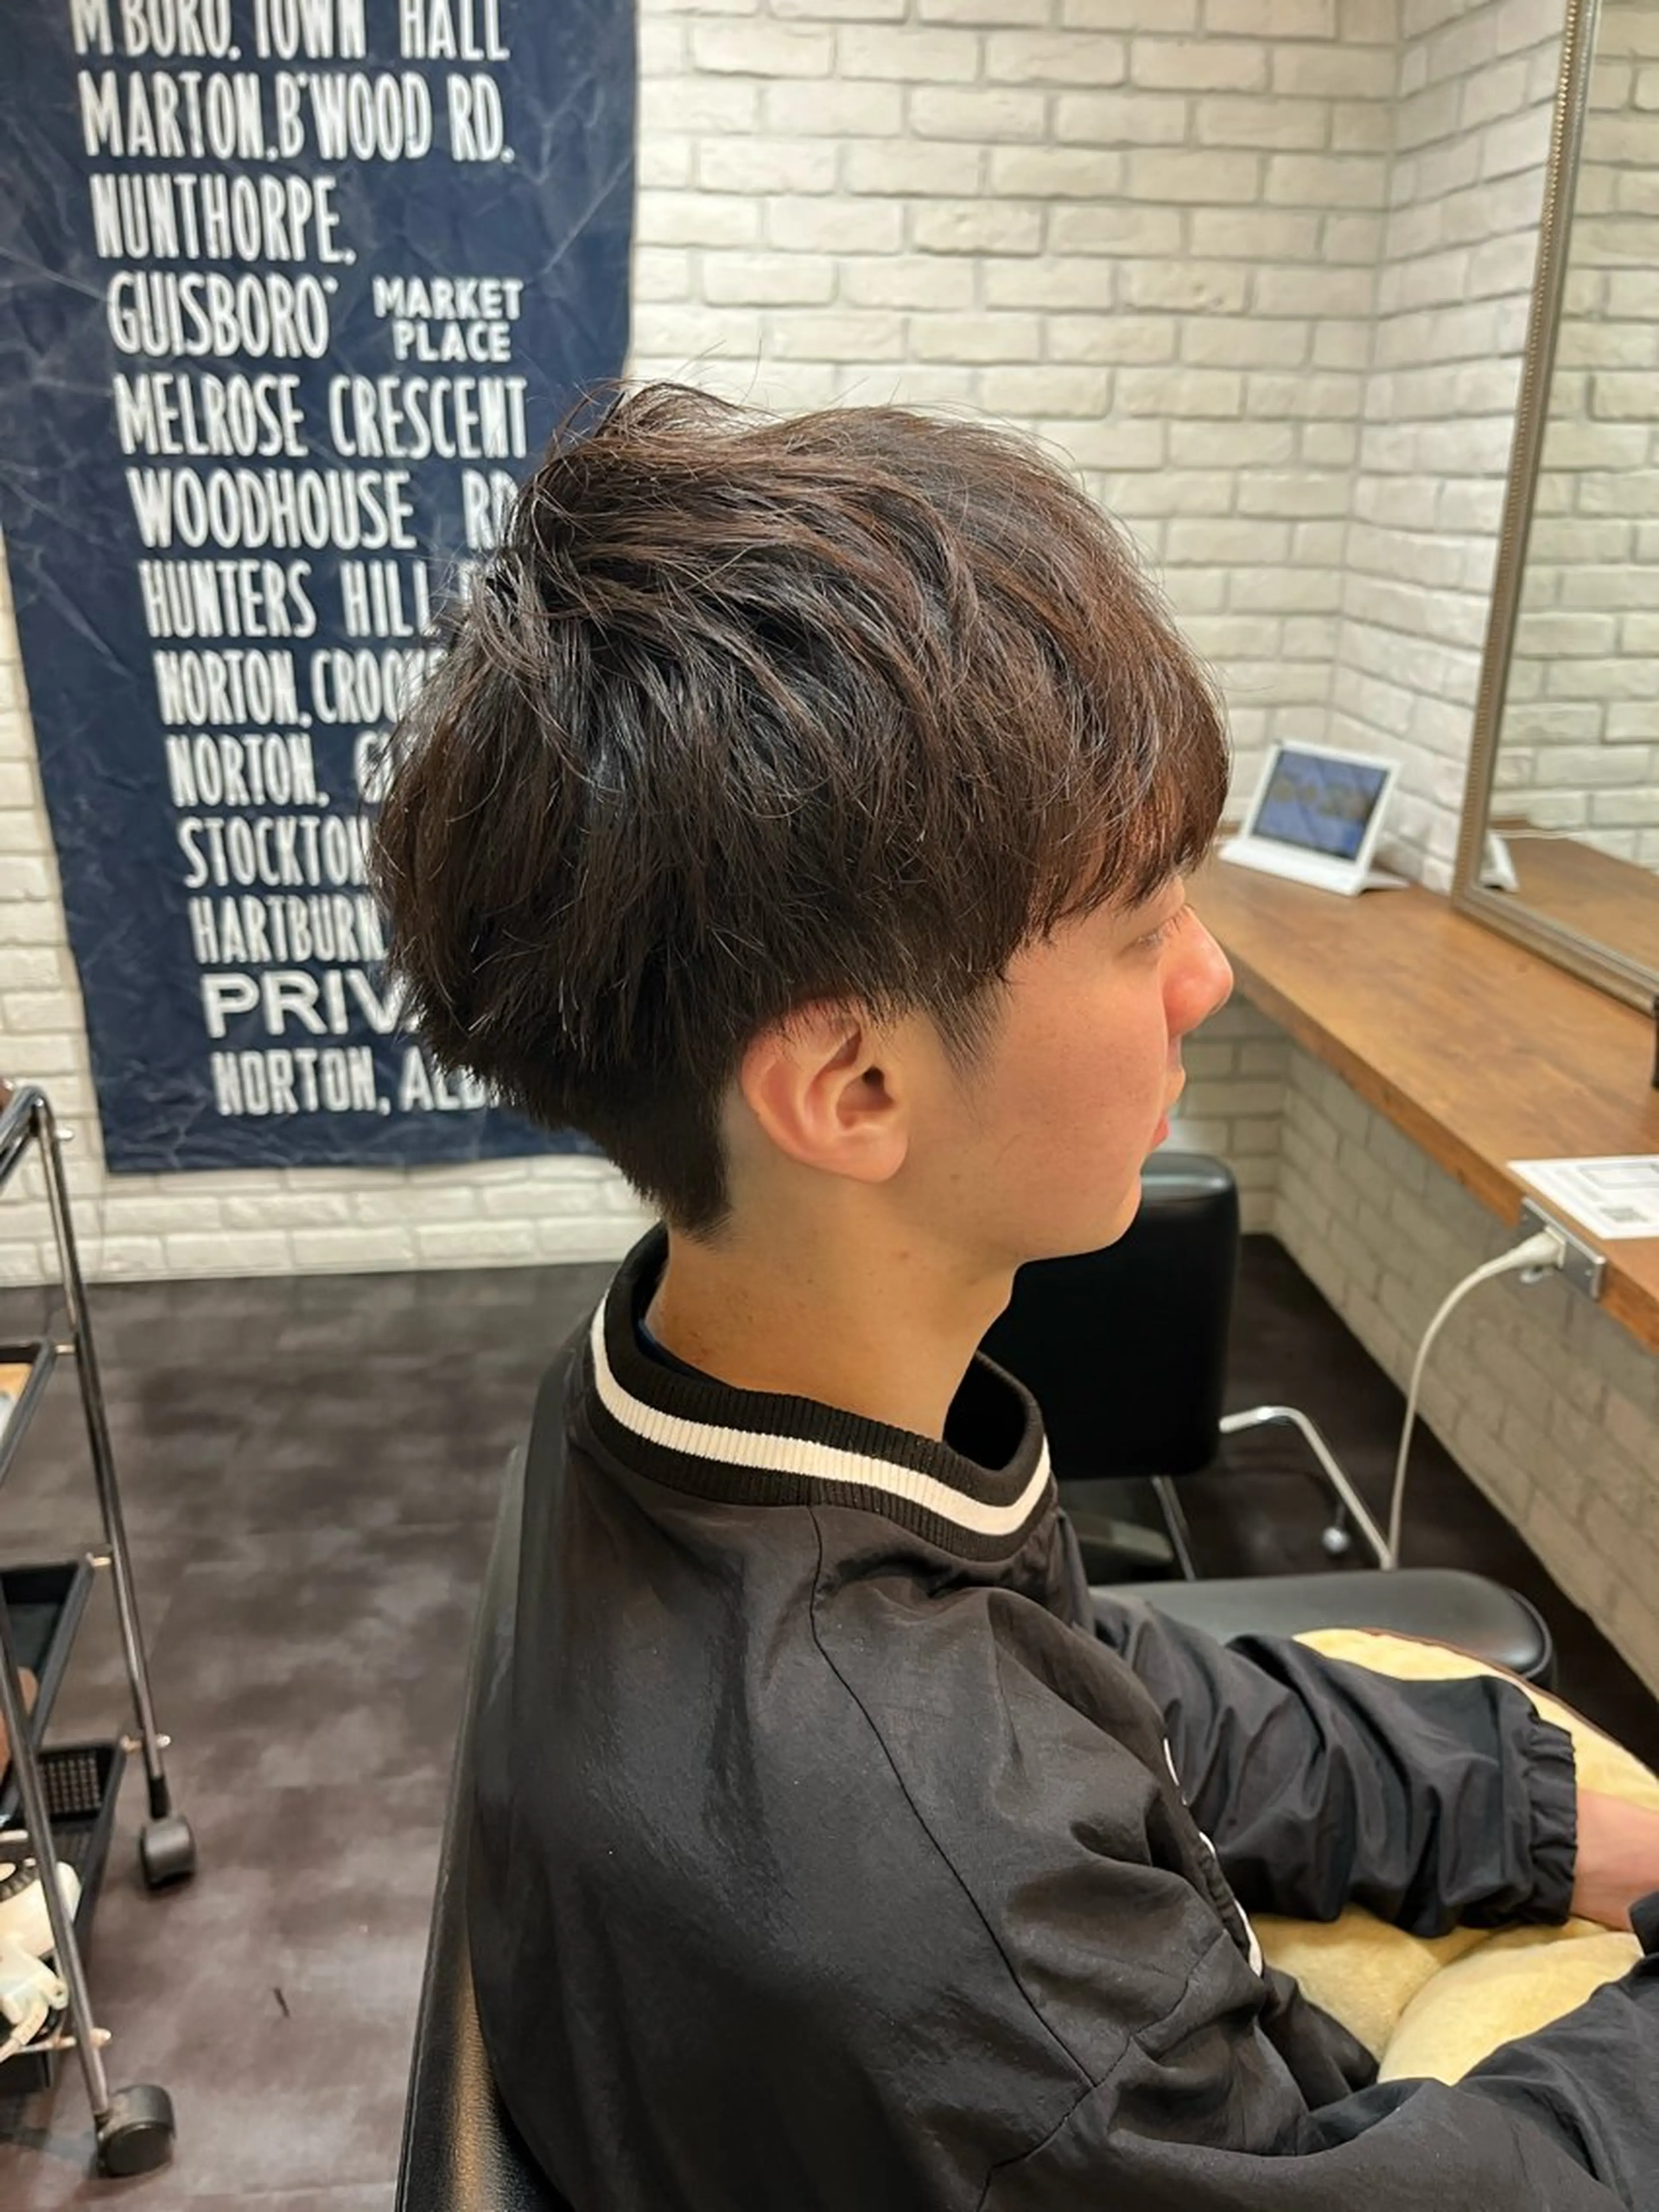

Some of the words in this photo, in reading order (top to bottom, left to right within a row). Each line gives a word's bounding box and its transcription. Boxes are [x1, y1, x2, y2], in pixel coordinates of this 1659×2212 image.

[400, 0, 510, 61] HALL
[447, 73, 515, 163] RD.
[89, 173, 356, 265] NUNTHORPE.
[372, 276, 524, 319] MARKET
[392, 321, 511, 362] PLACE
[112, 372, 308, 457] MELROSE
[329, 375, 528, 459] CRESCENT
[125, 467, 417, 550] WOODHOUSE
[138, 559, 316, 638] HUNTERS
[340, 560, 440, 637] HILL
[165, 733, 329, 807] NORTON.
[178, 815, 372, 888] STOCKTON
[211, 1046, 390, 1116] NORTON,
